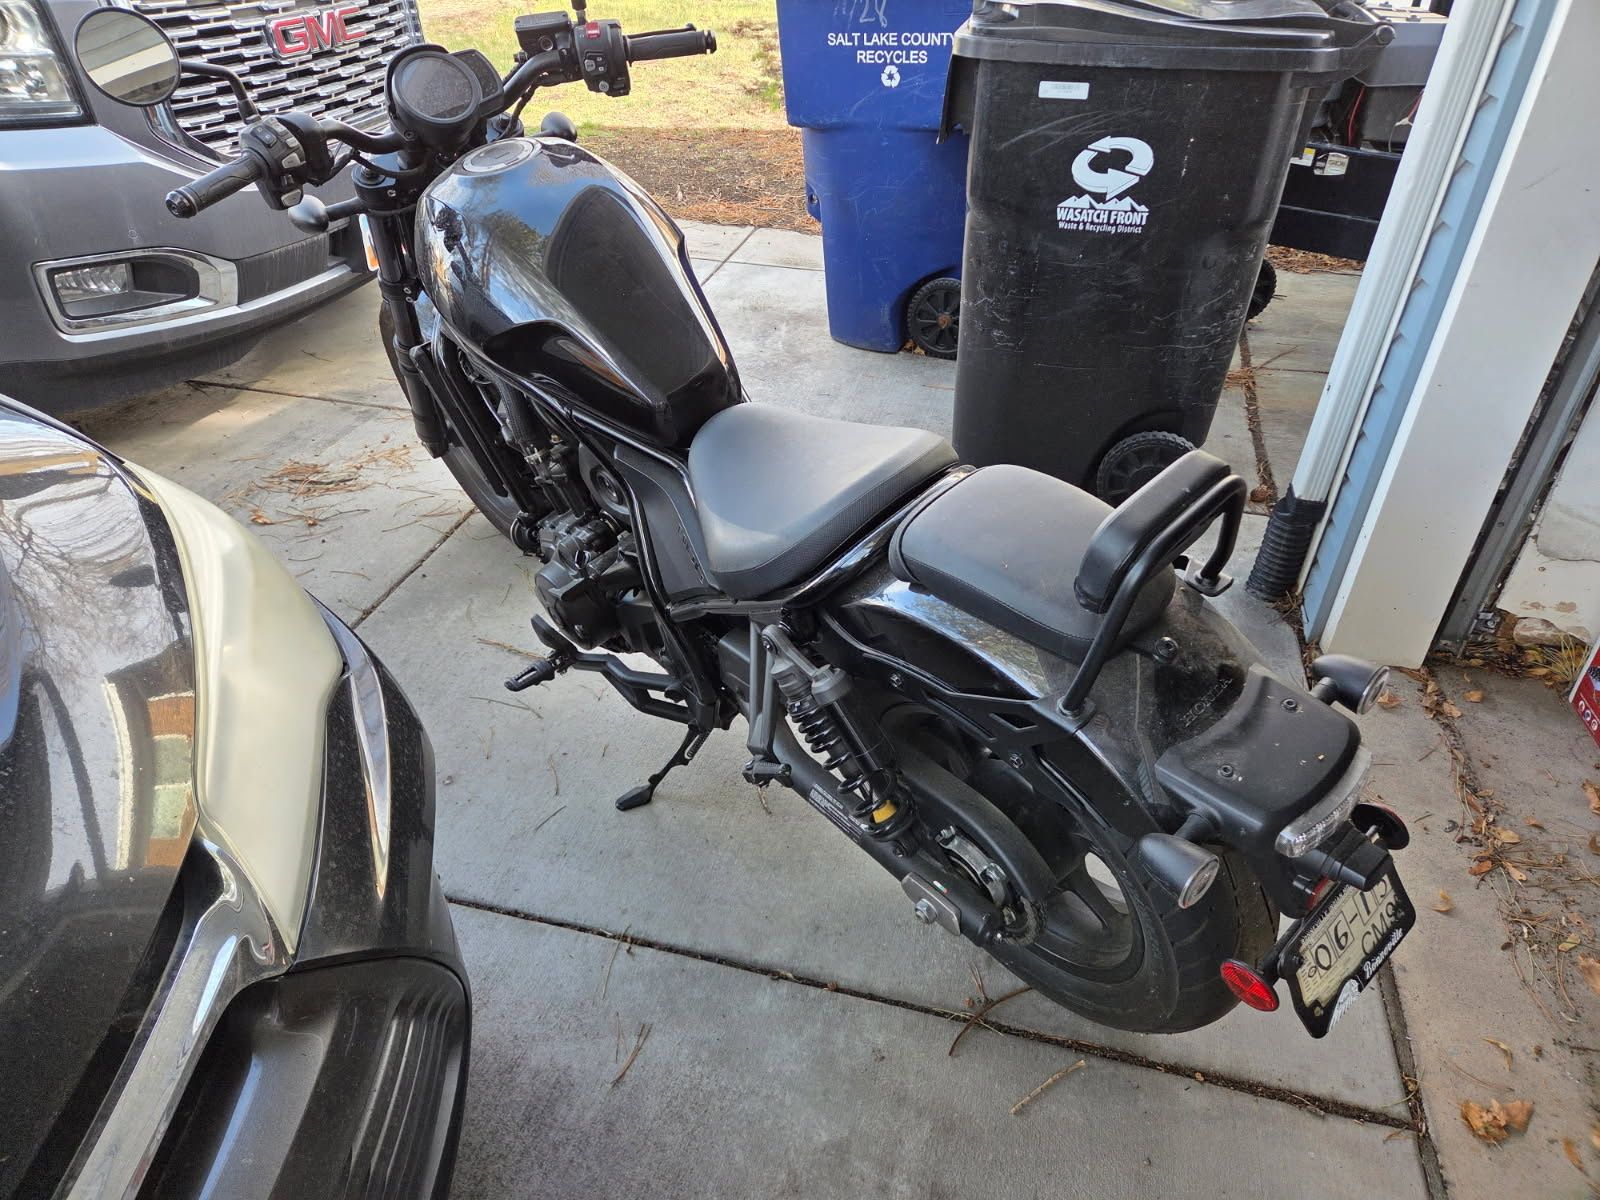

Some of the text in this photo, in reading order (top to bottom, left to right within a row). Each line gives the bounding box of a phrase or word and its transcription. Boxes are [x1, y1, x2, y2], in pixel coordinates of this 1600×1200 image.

[271, 6, 367, 55] GMC
[827, 32, 861, 46] SALT
[863, 32, 897, 46] LAKE
[856, 50, 928, 64] RECYCLES
[1056, 207, 1149, 226] WASATCH FRONT
[1058, 221, 1077, 230] Waste
[1085, 223, 1116, 234] Recycling
[1117, 225, 1142, 234] District
